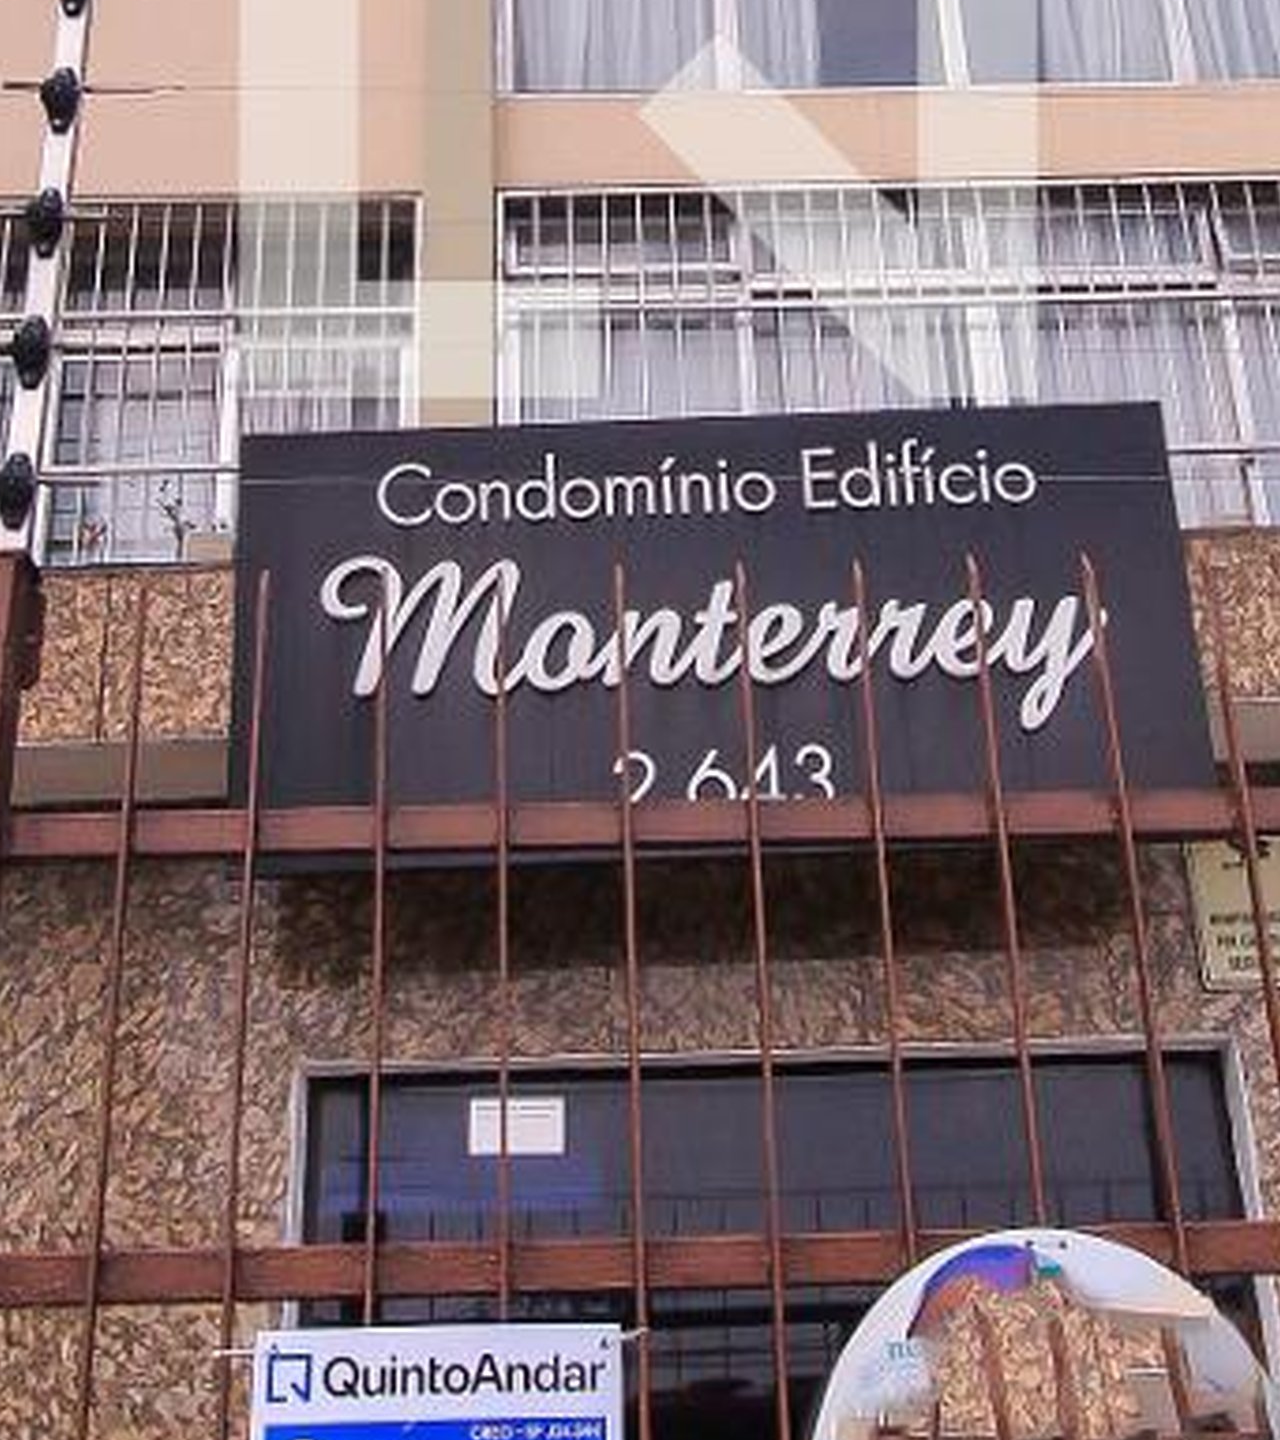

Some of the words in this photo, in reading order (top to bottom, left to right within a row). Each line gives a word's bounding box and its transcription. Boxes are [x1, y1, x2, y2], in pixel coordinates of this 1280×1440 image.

[376, 454, 776, 526] Condomínio
[800, 439, 1039, 510] Edifício
[319, 554, 1108, 731] Monterrey
[322, 1352, 606, 1398] QuintoAndar
